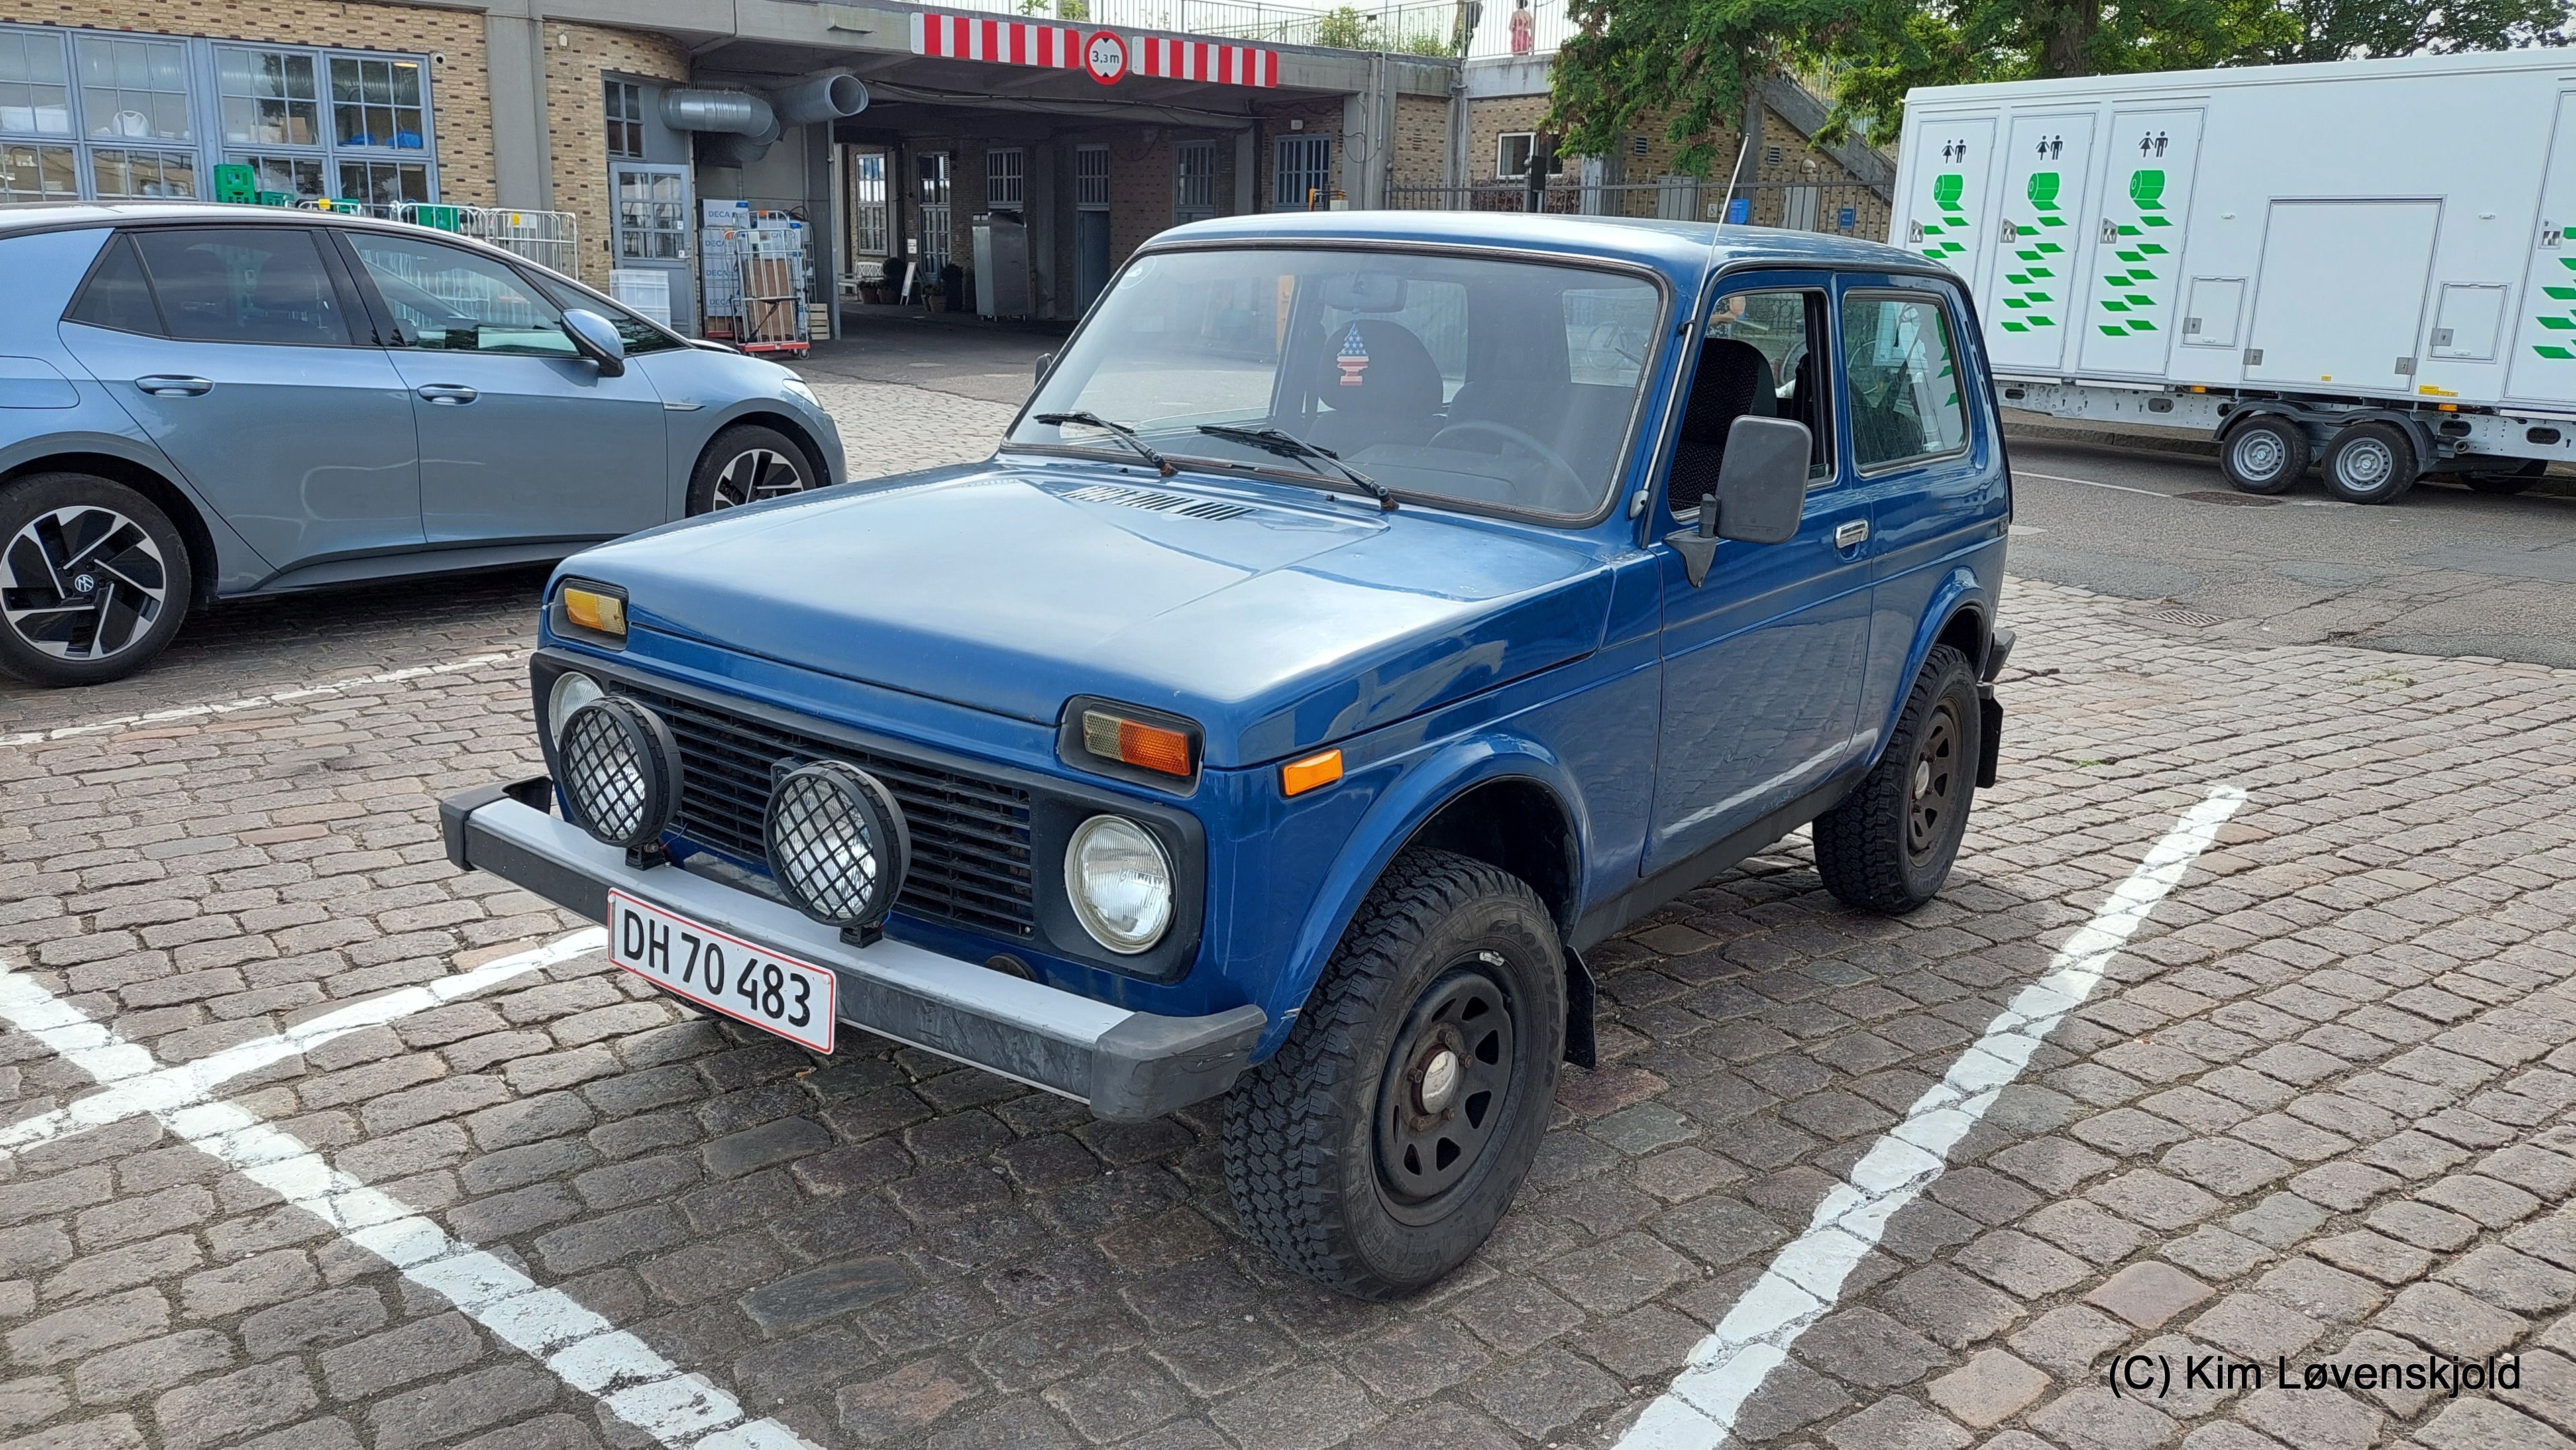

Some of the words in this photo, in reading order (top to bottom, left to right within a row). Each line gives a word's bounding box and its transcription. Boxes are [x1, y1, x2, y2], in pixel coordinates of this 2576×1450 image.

[624, 909, 669, 974] DH
[681, 932, 724, 995] 70
[737, 958, 810, 1027] 483
